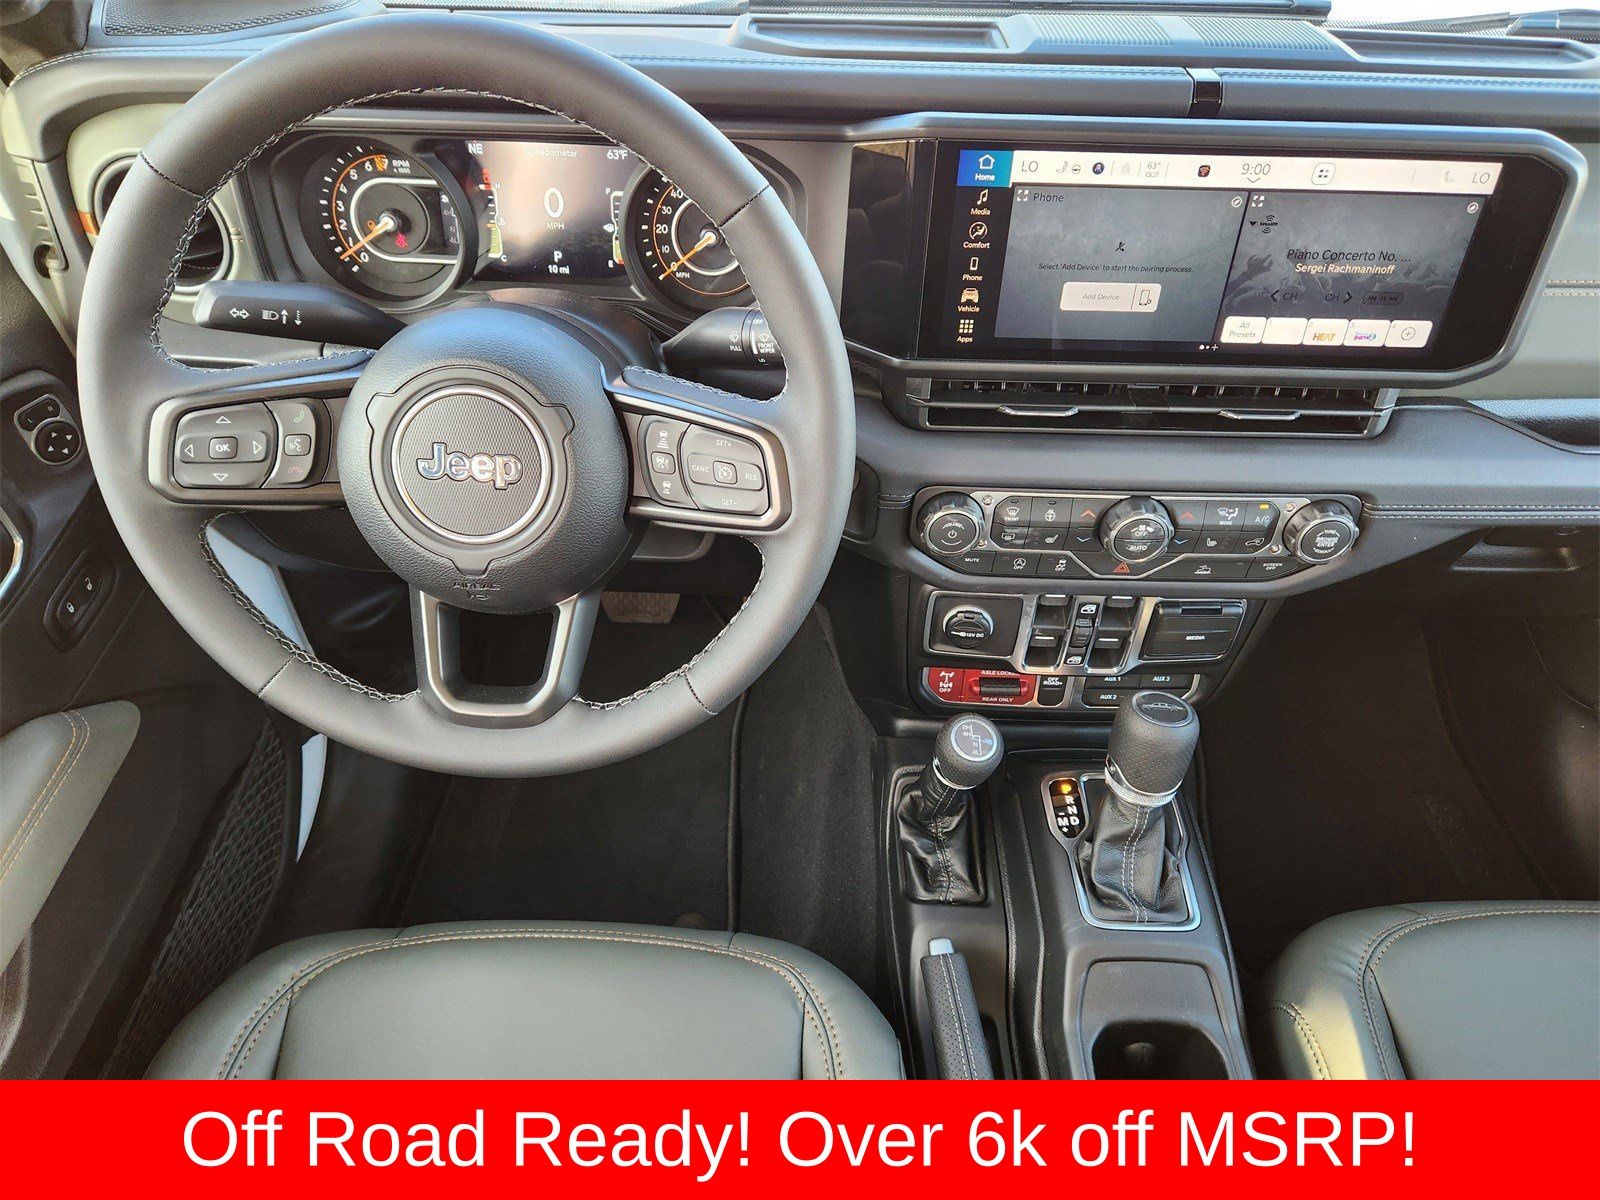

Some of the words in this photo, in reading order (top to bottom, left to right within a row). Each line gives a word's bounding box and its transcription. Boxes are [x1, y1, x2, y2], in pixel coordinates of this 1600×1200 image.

[468, 143, 484, 155] NE
[524, 147, 578, 158] Speedometer
[364, 161, 373, 172] 6
[392, 160, 410, 168] RPM
[1021, 161, 1038, 173] LO
[349, 169, 358, 180] 5
[1241, 163, 1271, 176] 9:00
[974, 173, 995, 181] Home
[1472, 172, 1491, 184] LO
[339, 183, 348, 194] 4
[671, 188, 684, 198] 40
[544, 187, 564, 218] 0
[1033, 192, 1064, 203] Phone
[336, 201, 345, 212] 3
[661, 205, 672, 215] 30
[970, 208, 991, 216] Media
[339, 219, 348, 231] 2
[546, 222, 565, 230] MPH
[656, 224, 668, 234] 20
[661, 245, 670, 253] 10
[963, 240, 990, 249] Comfort
[360, 252, 369, 263] 0
[553, 251, 562, 262] P
[1287, 249, 1319, 260] Piano
[1322, 250, 1376, 261] Concerto
[1378, 251, 1398, 262] No.
[559, 265, 569, 274] mi
[1038, 263, 1059, 271] Select
[1140, 265, 1164, 274] pairing
[1165, 267, 1194, 275] process.
[1295, 263, 1326, 274] Sergei
[1328, 264, 1395, 274] Rachmaninoff
[676, 271, 690, 279] MPH
[962, 273, 983, 282] Phone
[1283, 292, 1299, 301] CH
[1324, 293, 1340, 301] CH
[957, 304, 980, 313] Vehicle
[1239, 321, 1250, 329] All
[957, 335, 973, 344] Apps
[1229, 331, 1256, 339] Presets
[1312, 333, 1336, 341] HEAT
[215, 444, 230, 452] OK
[416, 442, 523, 490] Jeep
[691, 465, 710, 473] CANC
[745, 473, 757, 481] RES
[1255, 515, 1270, 523] A/C
[1064, 795, 1075, 804] R
[1067, 805, 1078, 815] N
[1057, 816, 1070, 826] M
[1070, 816, 1080, 826] D
